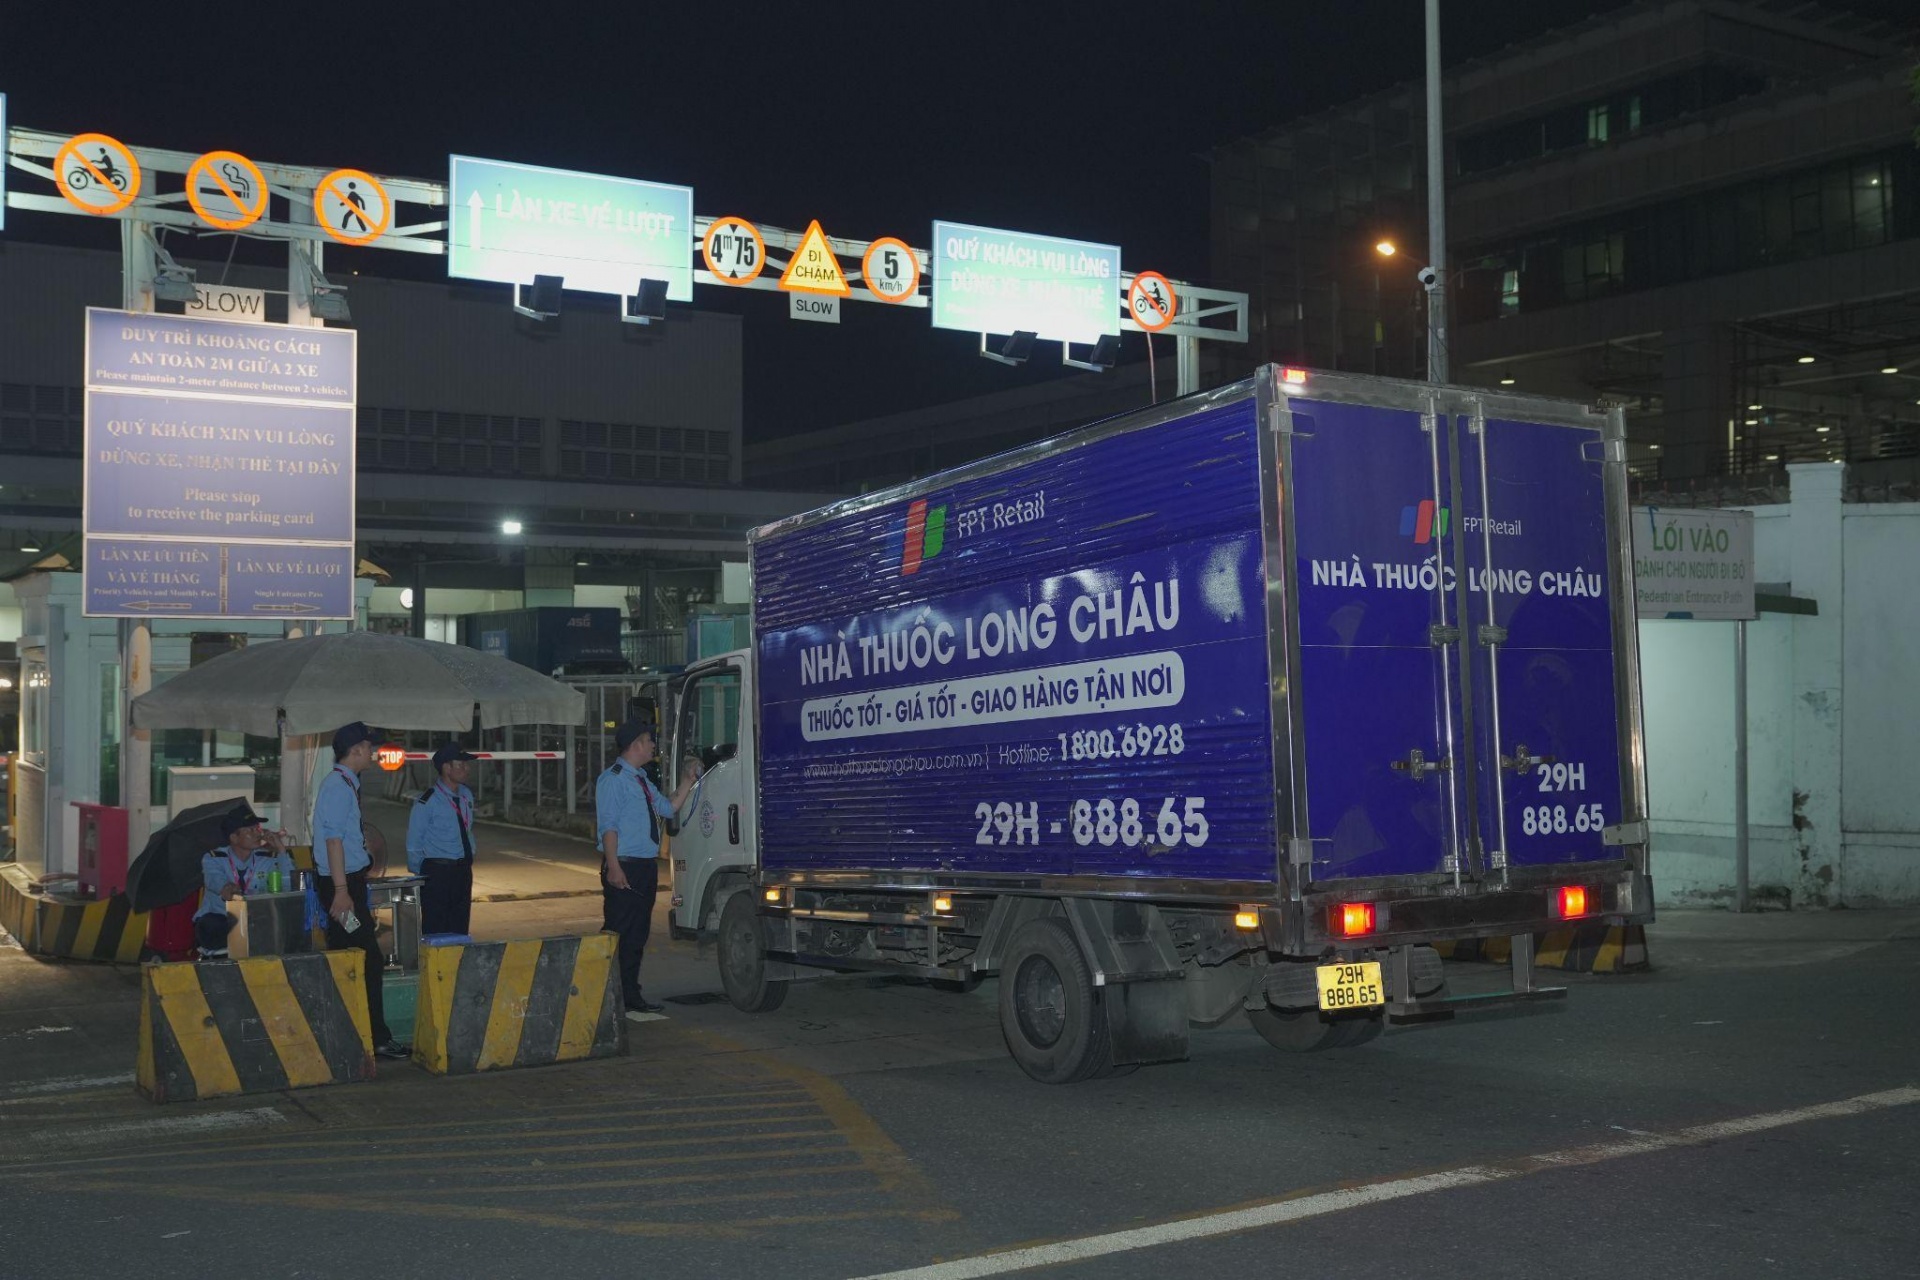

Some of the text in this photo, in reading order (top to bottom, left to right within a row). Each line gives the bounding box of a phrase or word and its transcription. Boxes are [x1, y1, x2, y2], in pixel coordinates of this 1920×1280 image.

[496, 189, 543, 223] LÀN
[547, 199, 577, 225] XE
[582, 200, 612, 230] VÉ
[808, 250, 822, 263] ĐI
[884, 251, 899, 279] 5
[946, 236, 1110, 278] QUÝ KHÁCH VUI LÒNG
[795, 265, 834, 283] CHẬM
[879, 278, 903, 292] km/h
[190, 289, 261, 315] SLOW
[796, 299, 833, 315] SLOW
[121, 327, 321, 356] DUY TRÌ KHOẢNG CÁCH
[129, 351, 318, 378] AN TOÀN 2M GIỮA 2 XE
[96, 369, 348, 396] Please maintain 2-meter distance between 2 vehicles
[107, 418, 335, 447] QUÝ KHÁCH XIN VUI LÒNG
[239, 456, 272, 472] THẺ
[277, 460, 303, 476] TẠI
[185, 487, 260, 506] Please stop
[128, 506, 314, 526] to receive the parking card
[957, 490, 1046, 538] FPT Retail
[1463, 517, 1522, 536] FPT Retail
[1653, 519, 1729, 553] LỐI VÀO
[101, 546, 129, 561] LÀN
[133, 550, 151, 562] XE
[155, 548, 176, 562] ƯU
[107, 568, 127, 583] VÀ
[153, 569, 200, 586] THÁNG
[236, 558, 343, 578] LÀN XE VÉ LƯỢT
[1312, 553, 1602, 598] NHÀ THUỐC LONG CHÂU
[1636, 556, 1664, 579] DÀNH
[1666, 560, 1686, 578] CHO
[154, 589, 168, 597] and
[1638, 589, 1685, 602] Pedestrian
[800, 571, 1180, 686] NHÀ THUỐC LONG CHÂU
[808, 698, 854, 733] THUỐC
[857, 693, 883, 727] TỐT
[895, 691, 924, 723] GIÁ
[928, 684, 957, 719] TỐT
[971, 686, 1017, 714] GIAO
[1022, 672, 1078, 708] HÀNG
[1085, 668, 1125, 709] TẬN
[1131, 665, 1173, 697] NƠI
[998, 743, 1053, 765] Hotline:
[1058, 723, 1185, 761] 1800.6928
[379, 751, 402, 763] STOP
[1537, 763, 1585, 792] 29H
[975, 801, 1039, 846] 29H
[1073, 797, 1209, 847] 888.65
[1523, 804, 1604, 836] 888.65
[1336, 965, 1364, 985] 29H
[1327, 985, 1377, 1006] 888.65
